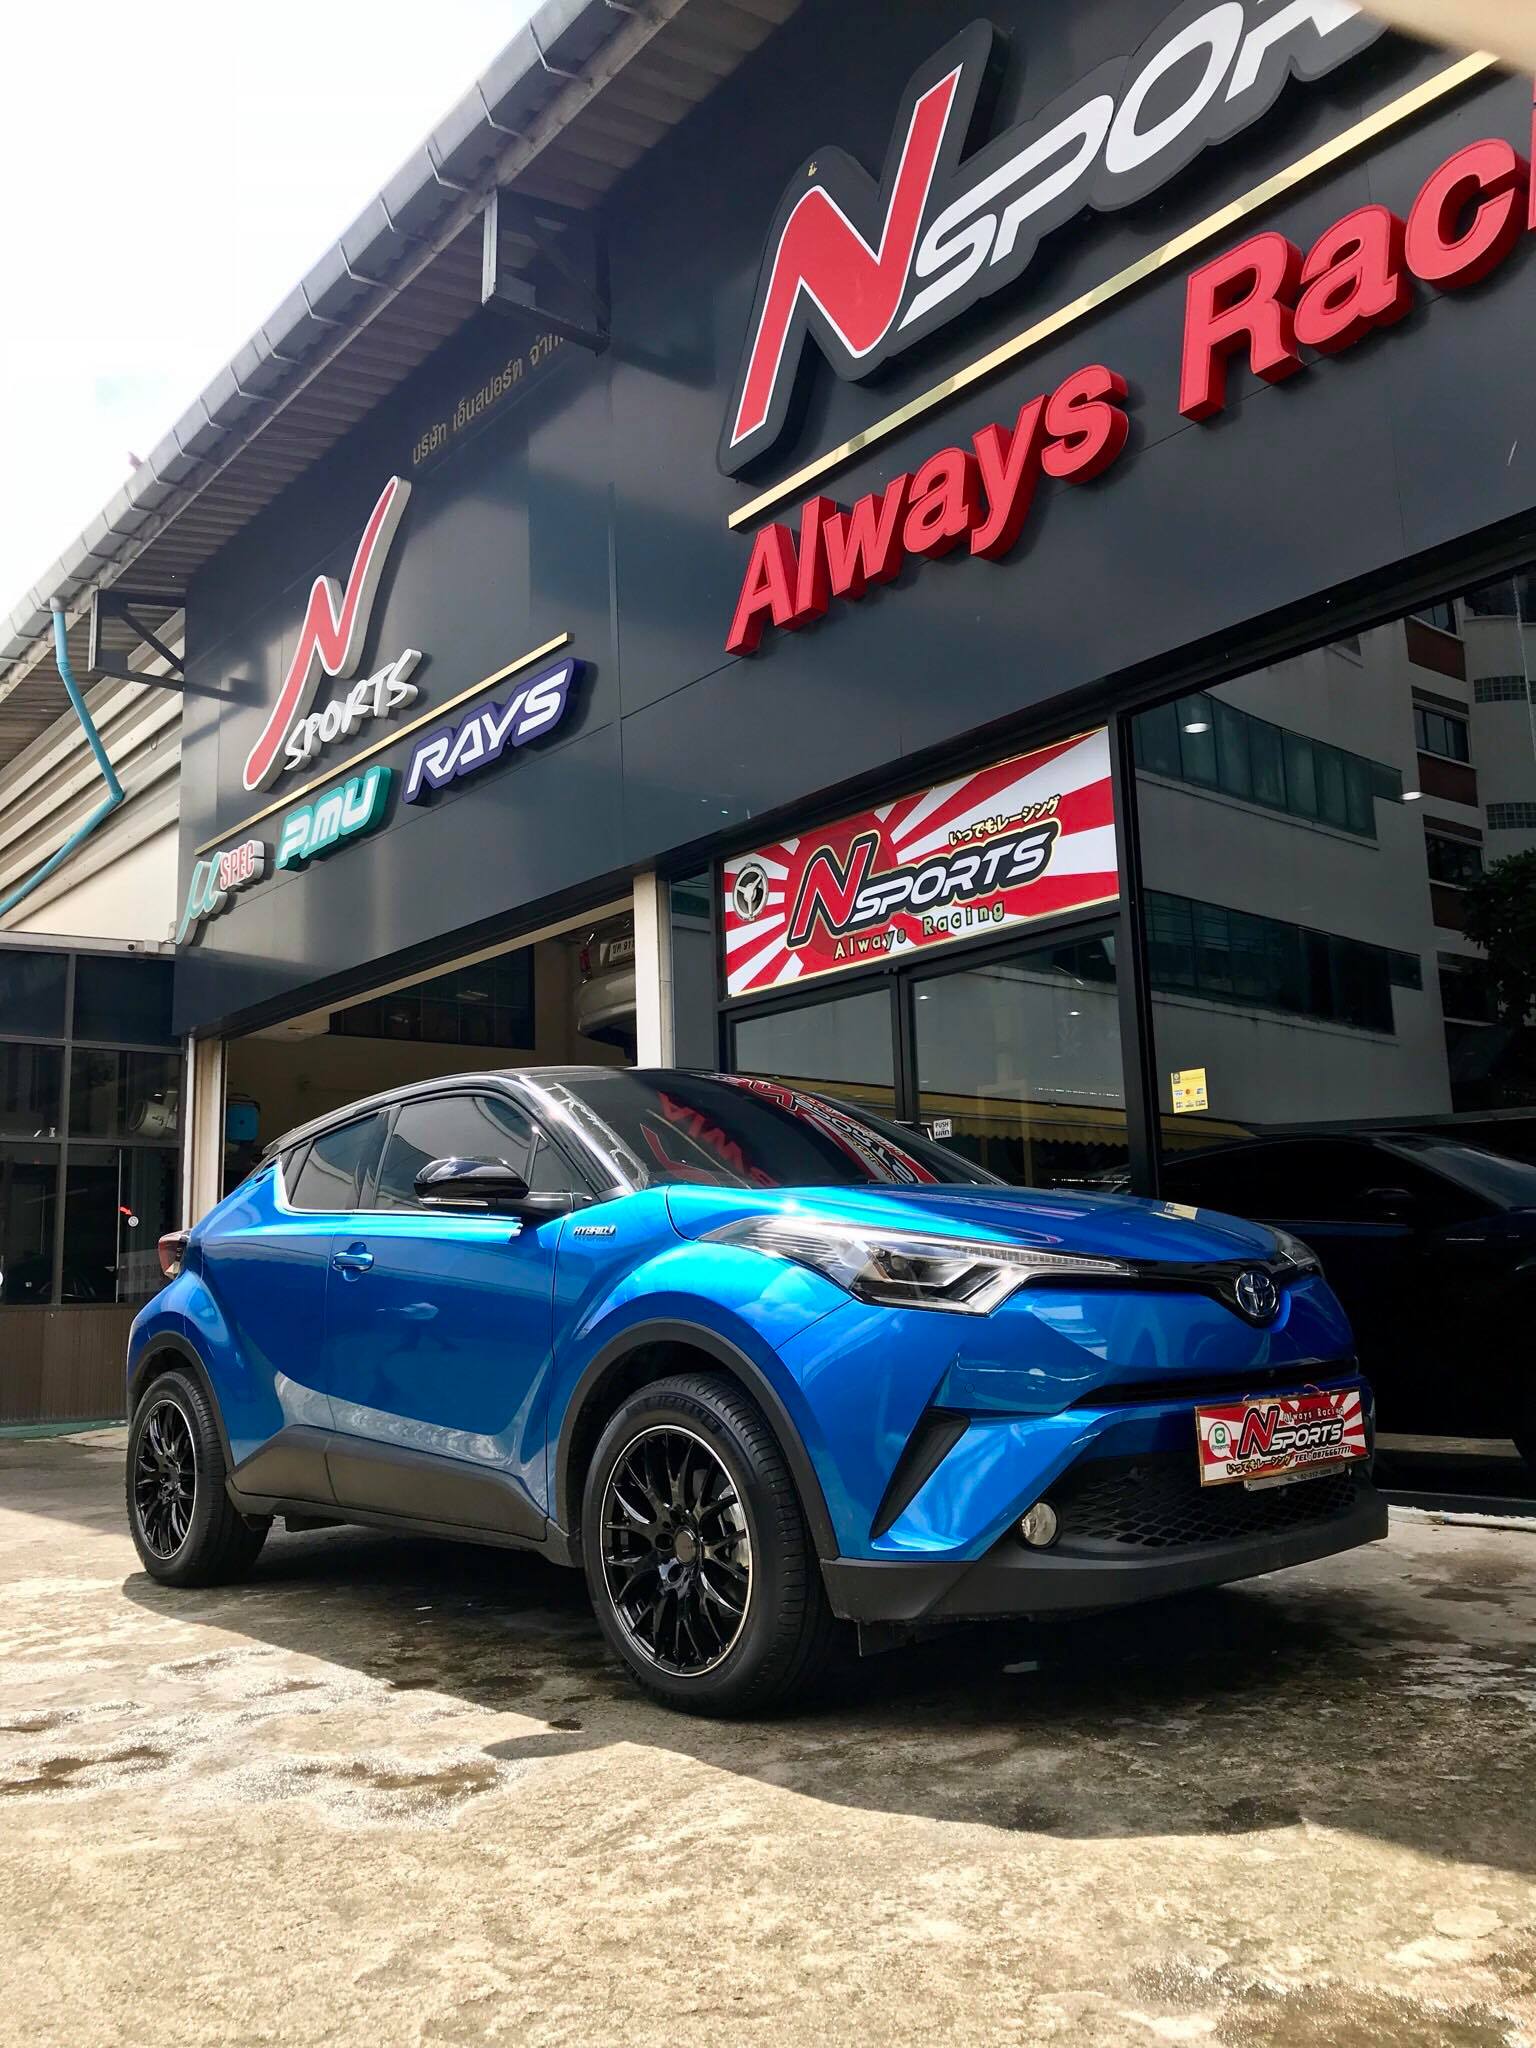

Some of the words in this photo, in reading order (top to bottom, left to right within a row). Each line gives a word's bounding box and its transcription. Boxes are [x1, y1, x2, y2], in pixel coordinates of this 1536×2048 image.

[413, 423, 447, 465] บริษัท
[453, 358, 523, 432] เอ็นสปอร์ต
[529, 333, 564, 366] จำก
[725, 364, 1130, 655] Always
[1180, 85, 1536, 423] Rac
[283, 649, 422, 772] SPORTS
[406, 666, 570, 796] RAYS
[219, 841, 259, 891] SPEC
[833, 928, 907, 961] Always
[922, 900, 1005, 938] Racing
[1317, 1405, 1344, 1417] Racing
